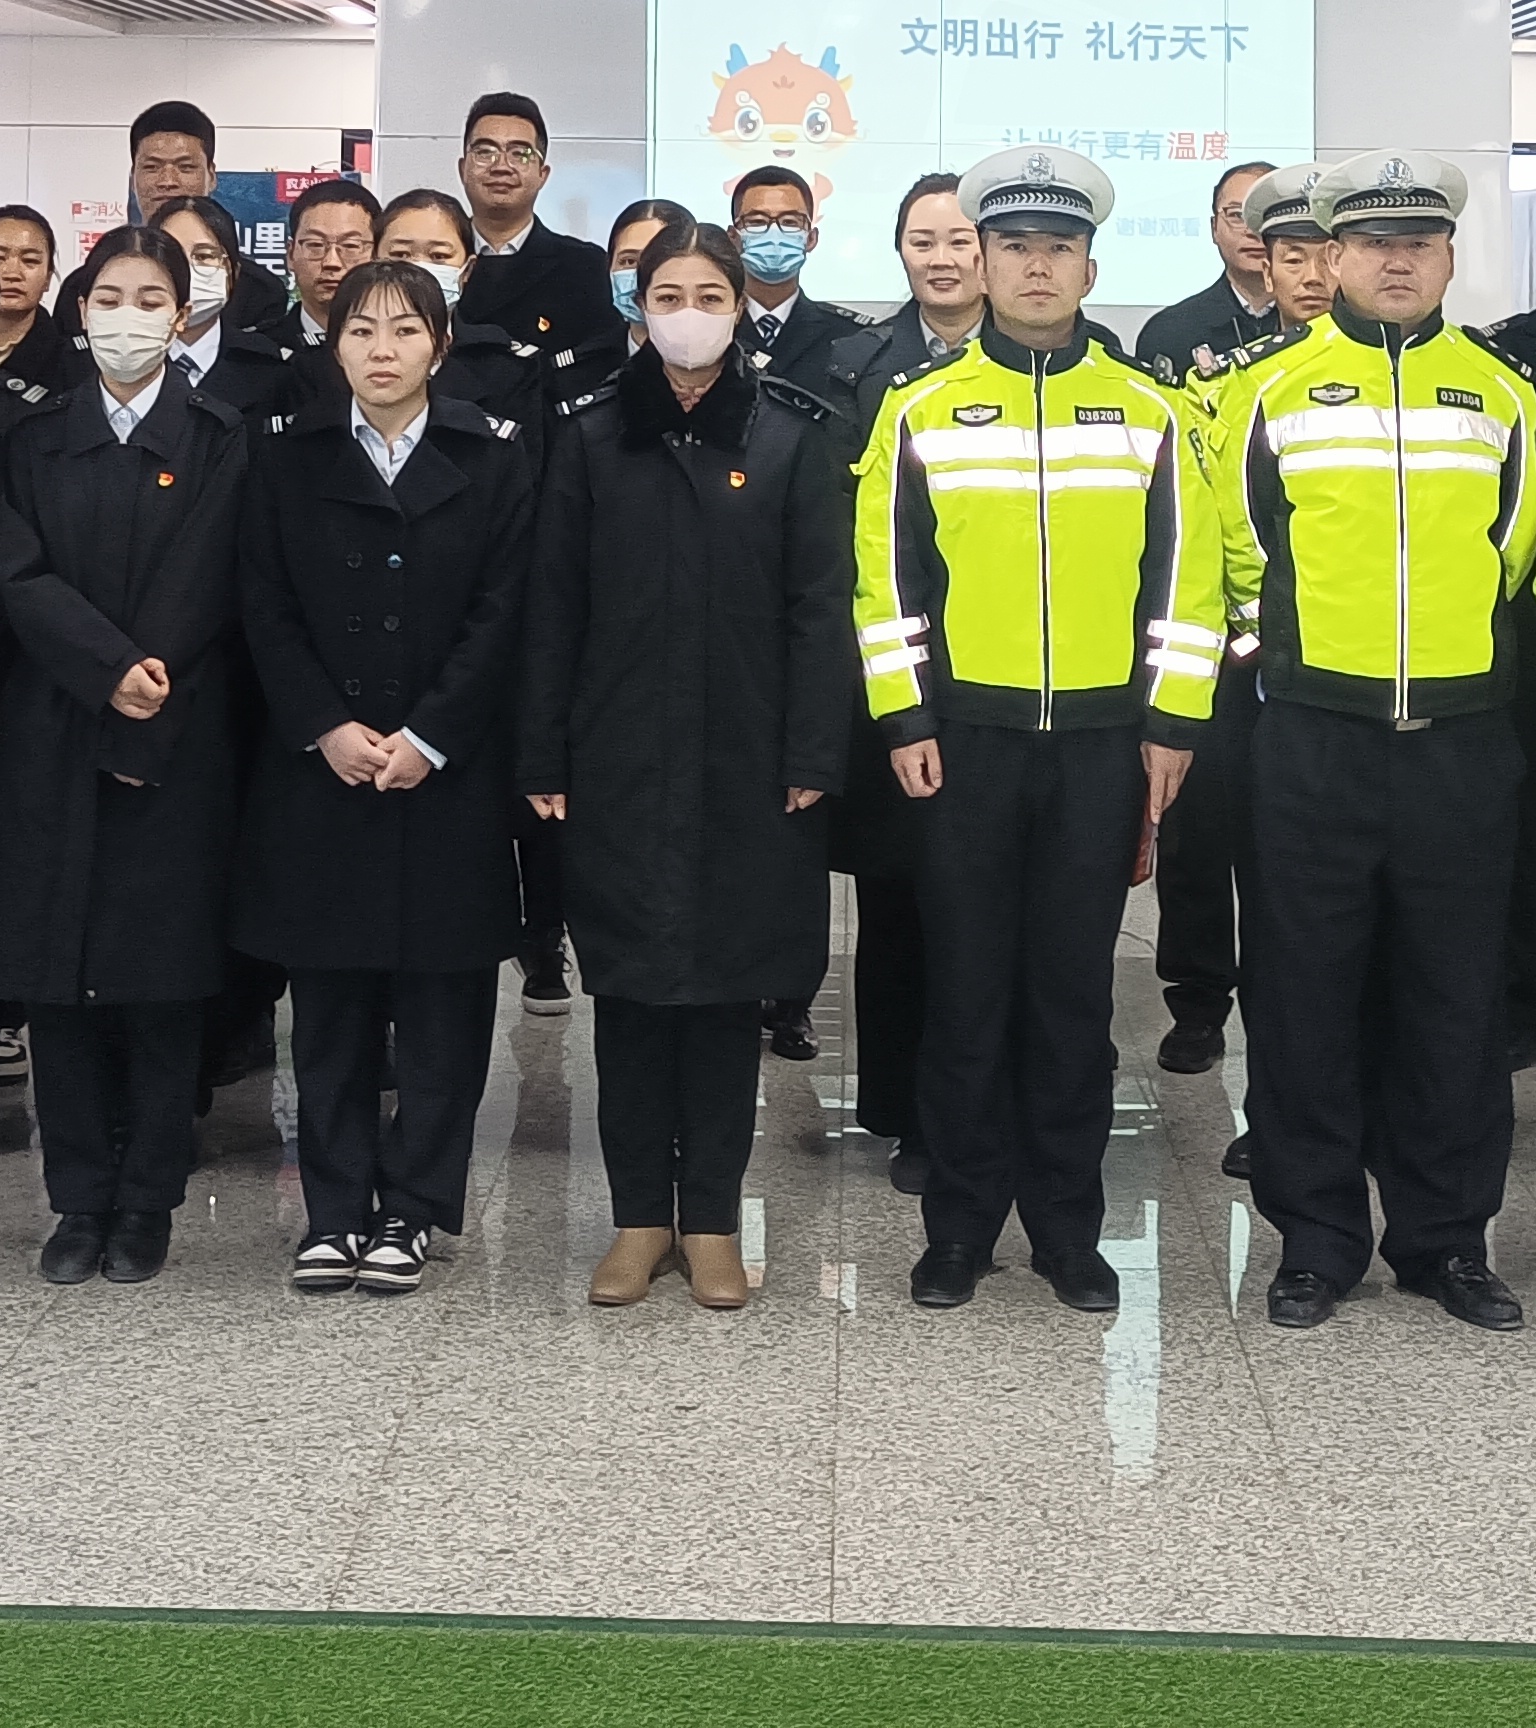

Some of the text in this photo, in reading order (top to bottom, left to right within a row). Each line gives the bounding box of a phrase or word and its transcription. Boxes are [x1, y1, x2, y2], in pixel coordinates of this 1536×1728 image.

[900, 17, 1249, 63] 文明出行 礼行天下
[1116, 217, 1202, 238] 谢谢观看
